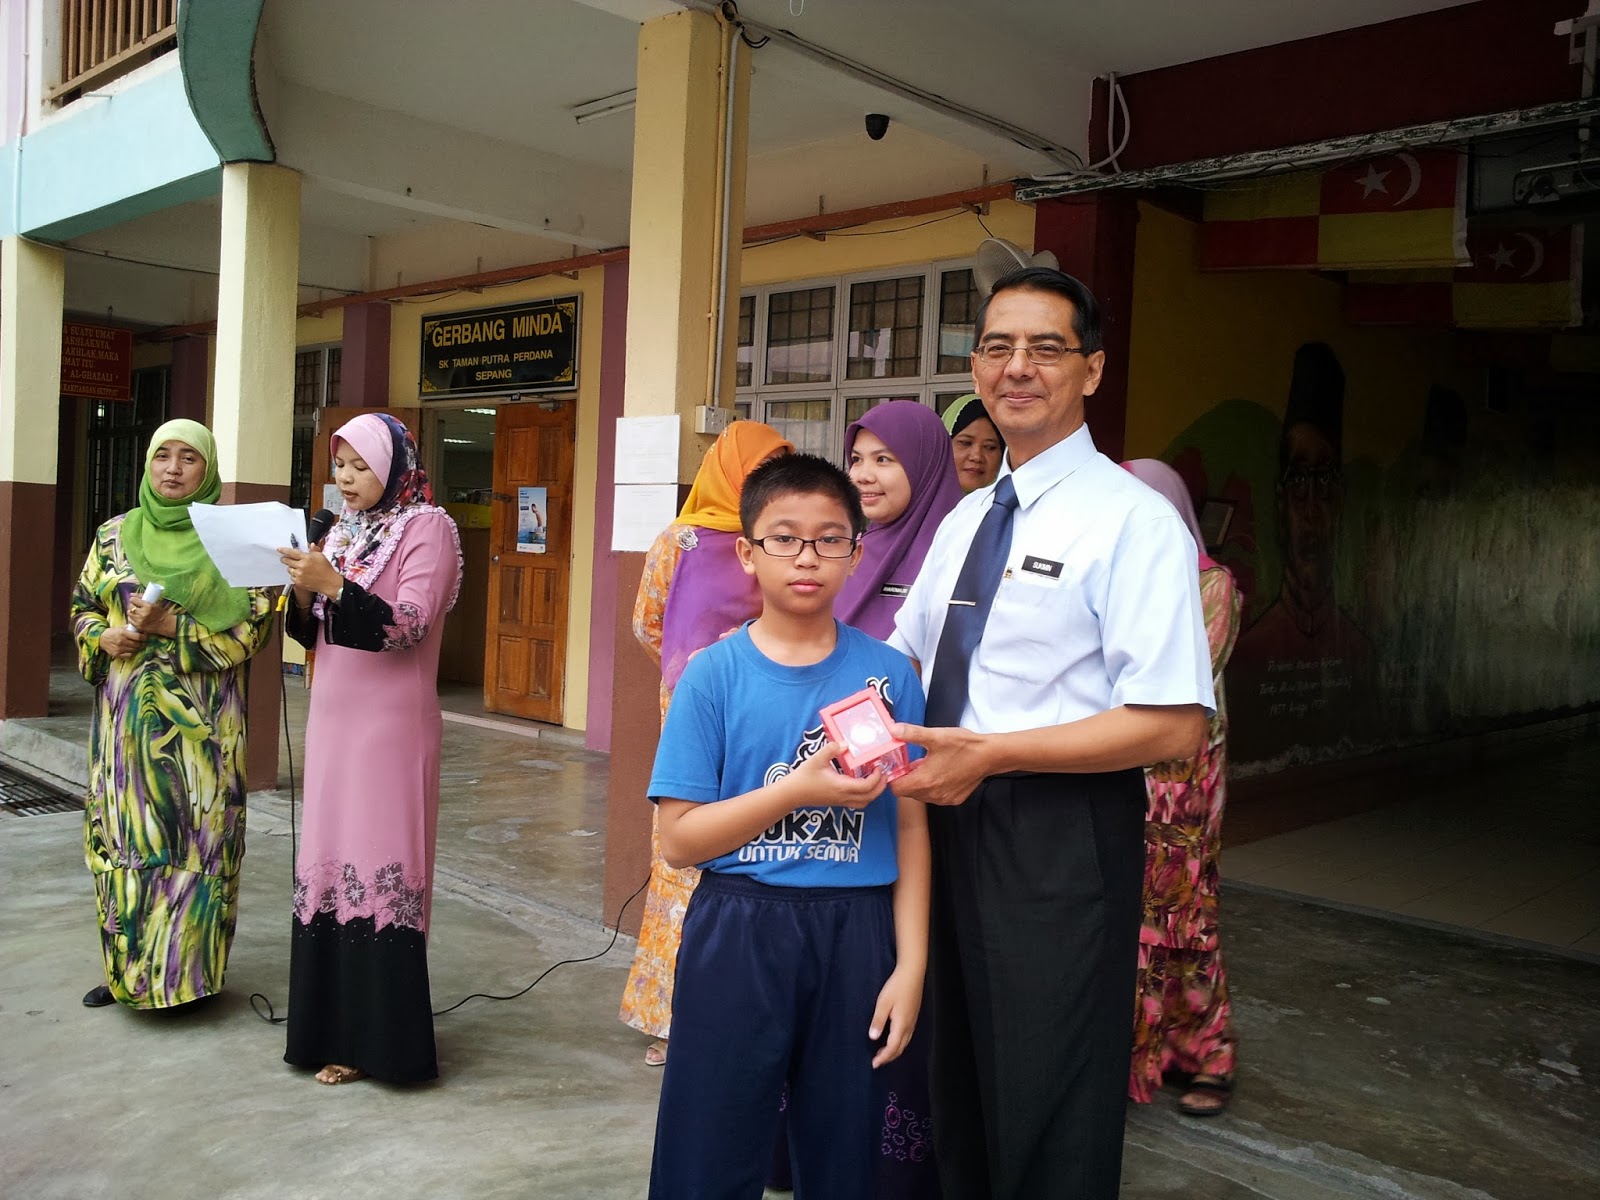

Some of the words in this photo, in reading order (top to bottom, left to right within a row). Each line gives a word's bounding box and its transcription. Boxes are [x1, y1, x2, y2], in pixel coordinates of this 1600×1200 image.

[70, 326, 94, 337] SUATU
[95, 329, 116, 340] UMAT
[432, 319, 505, 348] GERBANG
[512, 312, 563, 339] MINDA
[438, 359, 449, 369] SK
[452, 356, 479, 368] TAMAN
[481, 354, 510, 366] PUTRA
[513, 349, 554, 363] PERDANA
[69, 369, 113, 382] AL-GHAZALI
[475, 369, 512, 381] SEPANG
[749, 806, 865, 850] UKAN
[804, 843, 859, 863] SEMUA
